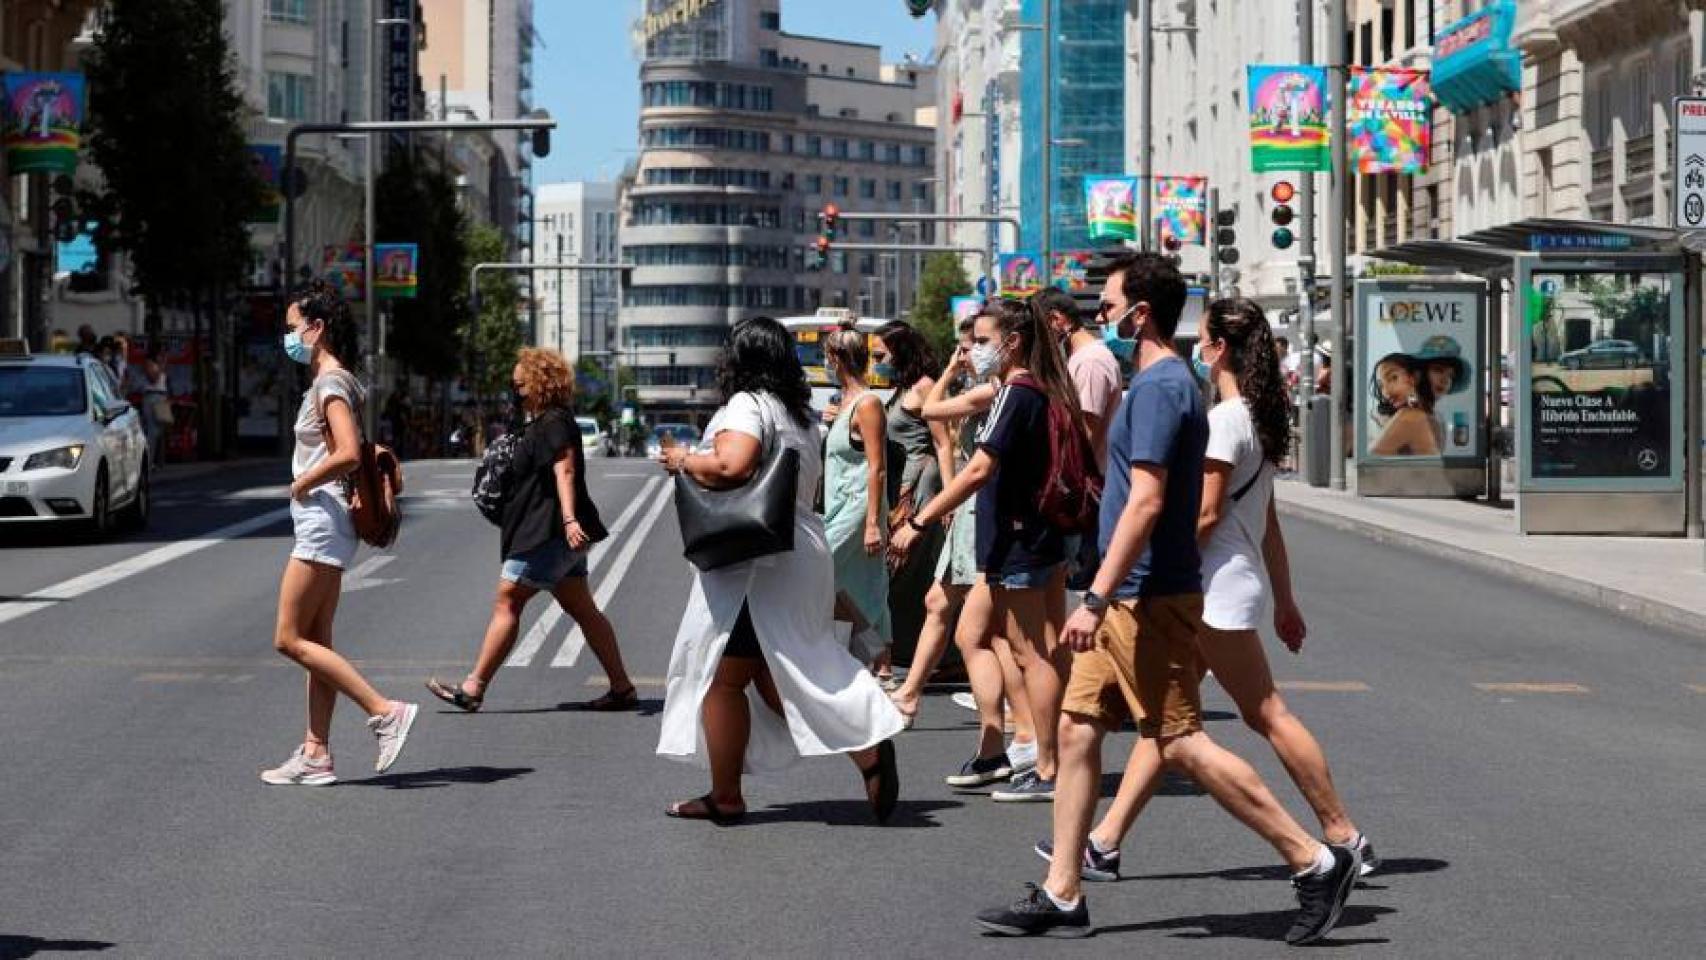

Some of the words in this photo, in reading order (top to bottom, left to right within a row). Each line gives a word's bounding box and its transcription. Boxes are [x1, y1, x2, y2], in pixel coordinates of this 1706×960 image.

[1682, 103, 1706, 117] PRE
[1379, 301, 1464, 323] LOEWE
[1575, 394, 1602, 407] Clase
[1604, 394, 1613, 407] A
